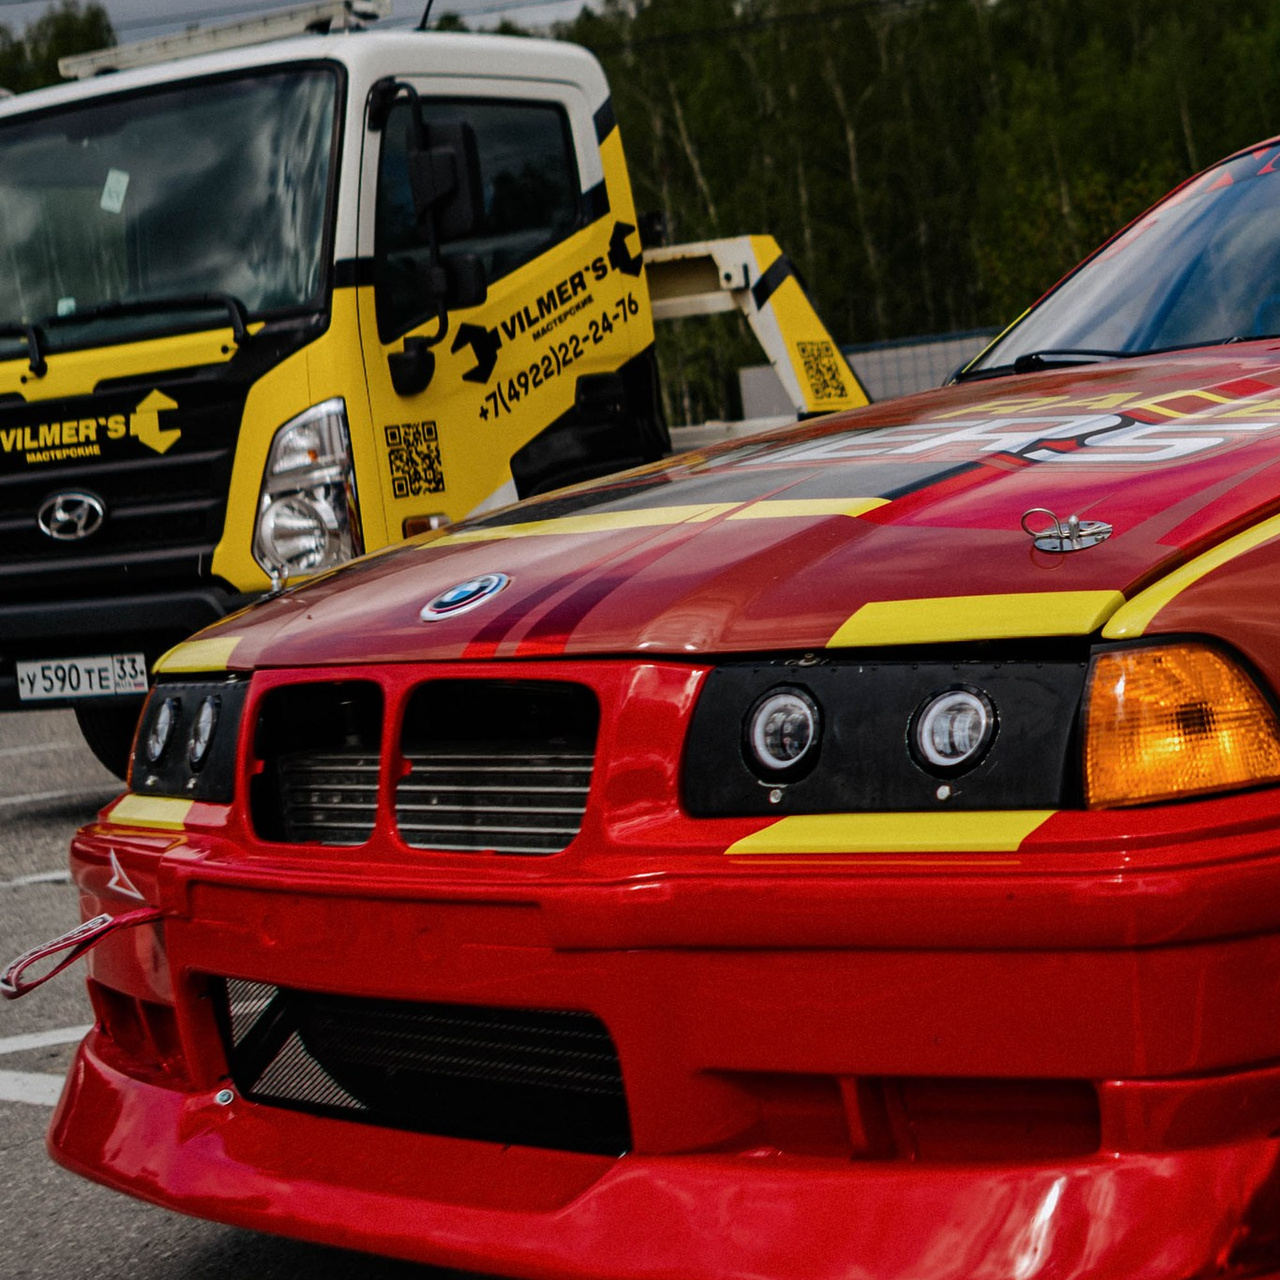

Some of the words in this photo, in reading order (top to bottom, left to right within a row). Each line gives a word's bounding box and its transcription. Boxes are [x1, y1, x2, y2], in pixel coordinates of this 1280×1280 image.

[532, 293, 594, 342] МАСТЕРСКИЕ
[479, 291, 639, 421] +7(4922)22-24-76
[116, 657, 138, 680] 33
